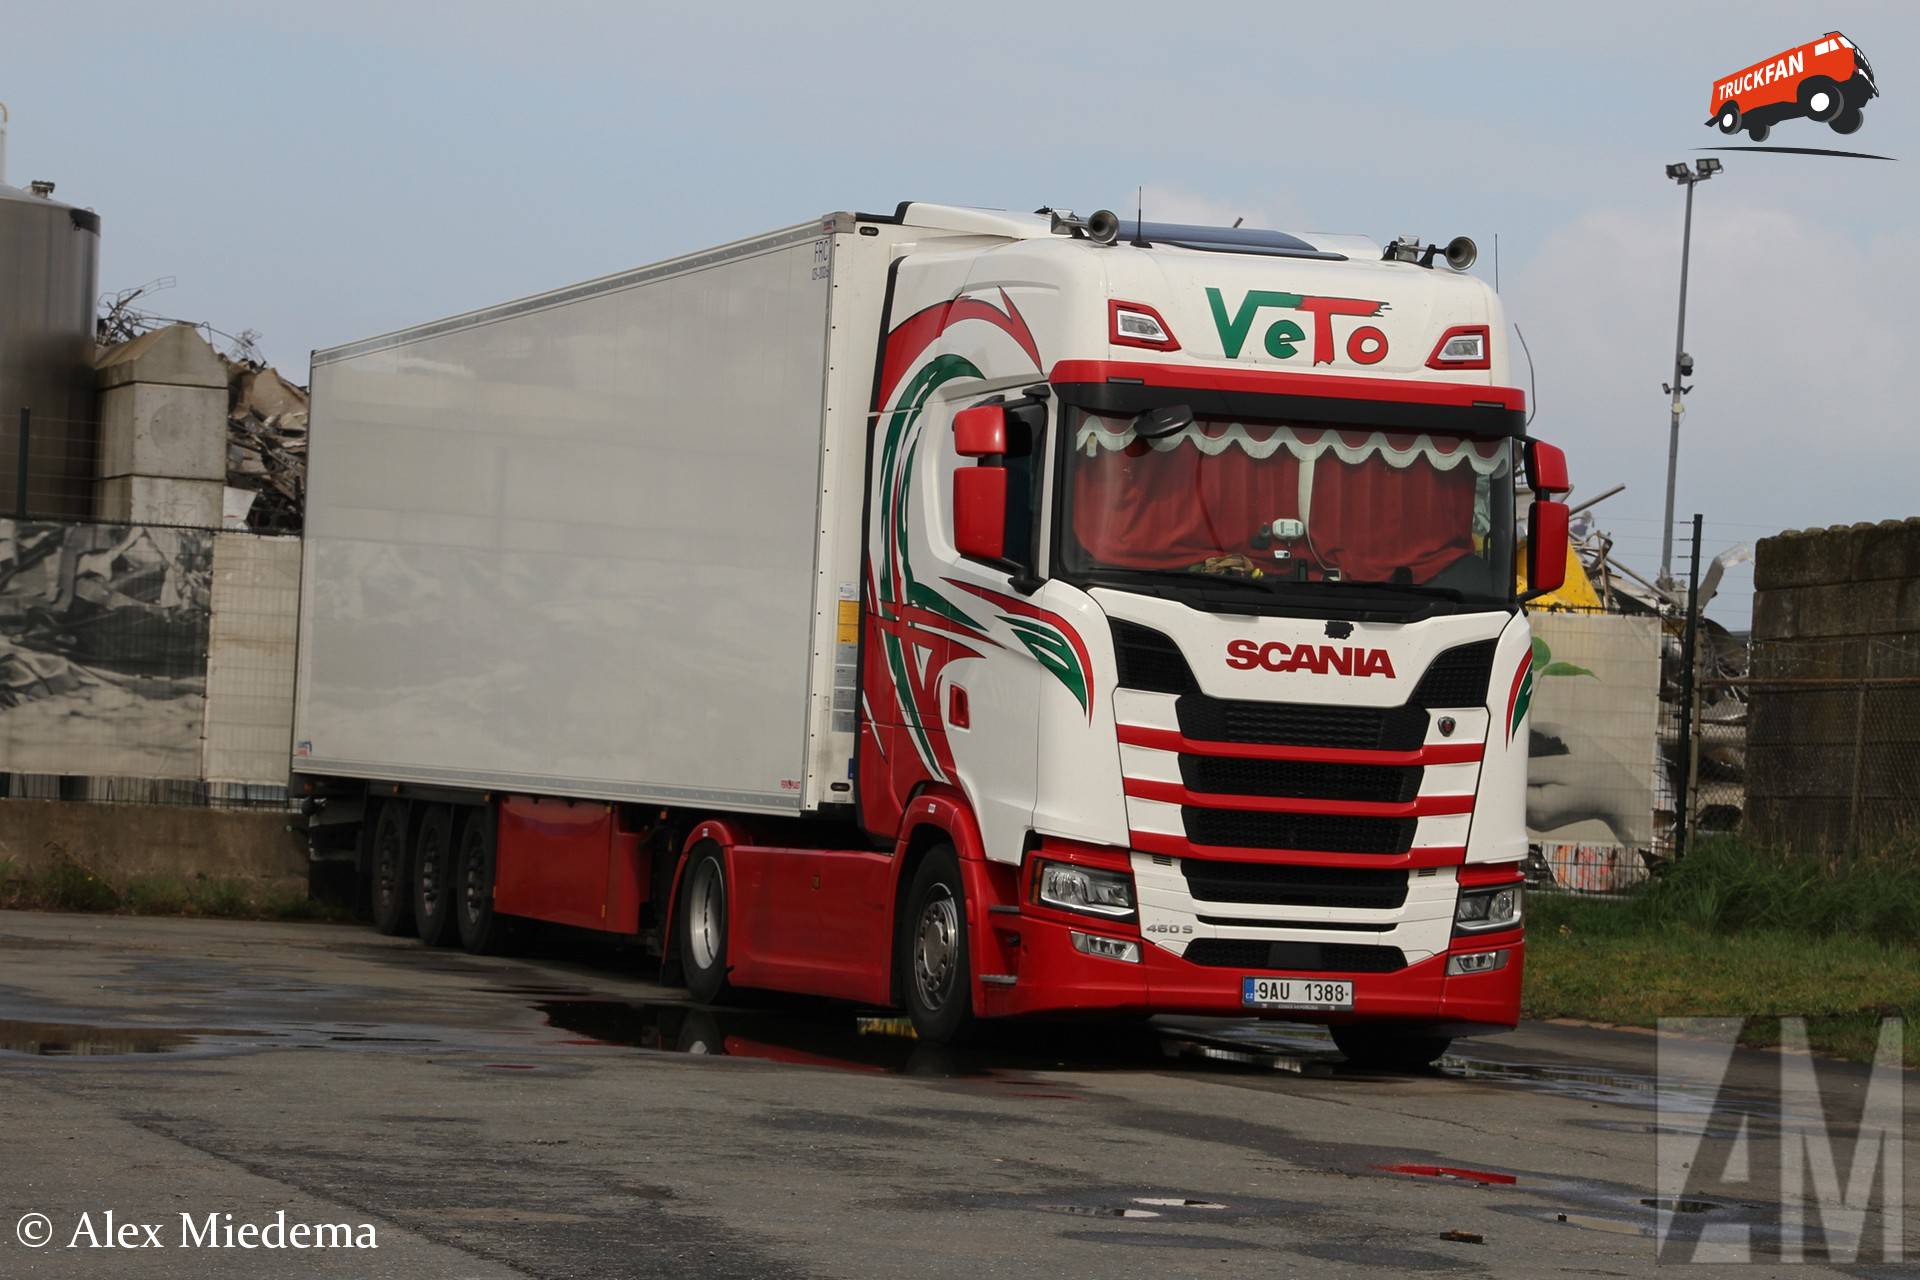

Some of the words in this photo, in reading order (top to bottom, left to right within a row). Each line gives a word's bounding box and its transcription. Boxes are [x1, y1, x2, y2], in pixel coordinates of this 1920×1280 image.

[1205, 287, 1392, 367] VeTo
[1226, 639, 1396, 679] SCANIA
[1182, 924, 1193, 934] S
[1258, 982, 1290, 1000] 9AU
[1304, 983, 1344, 1002] 1388
